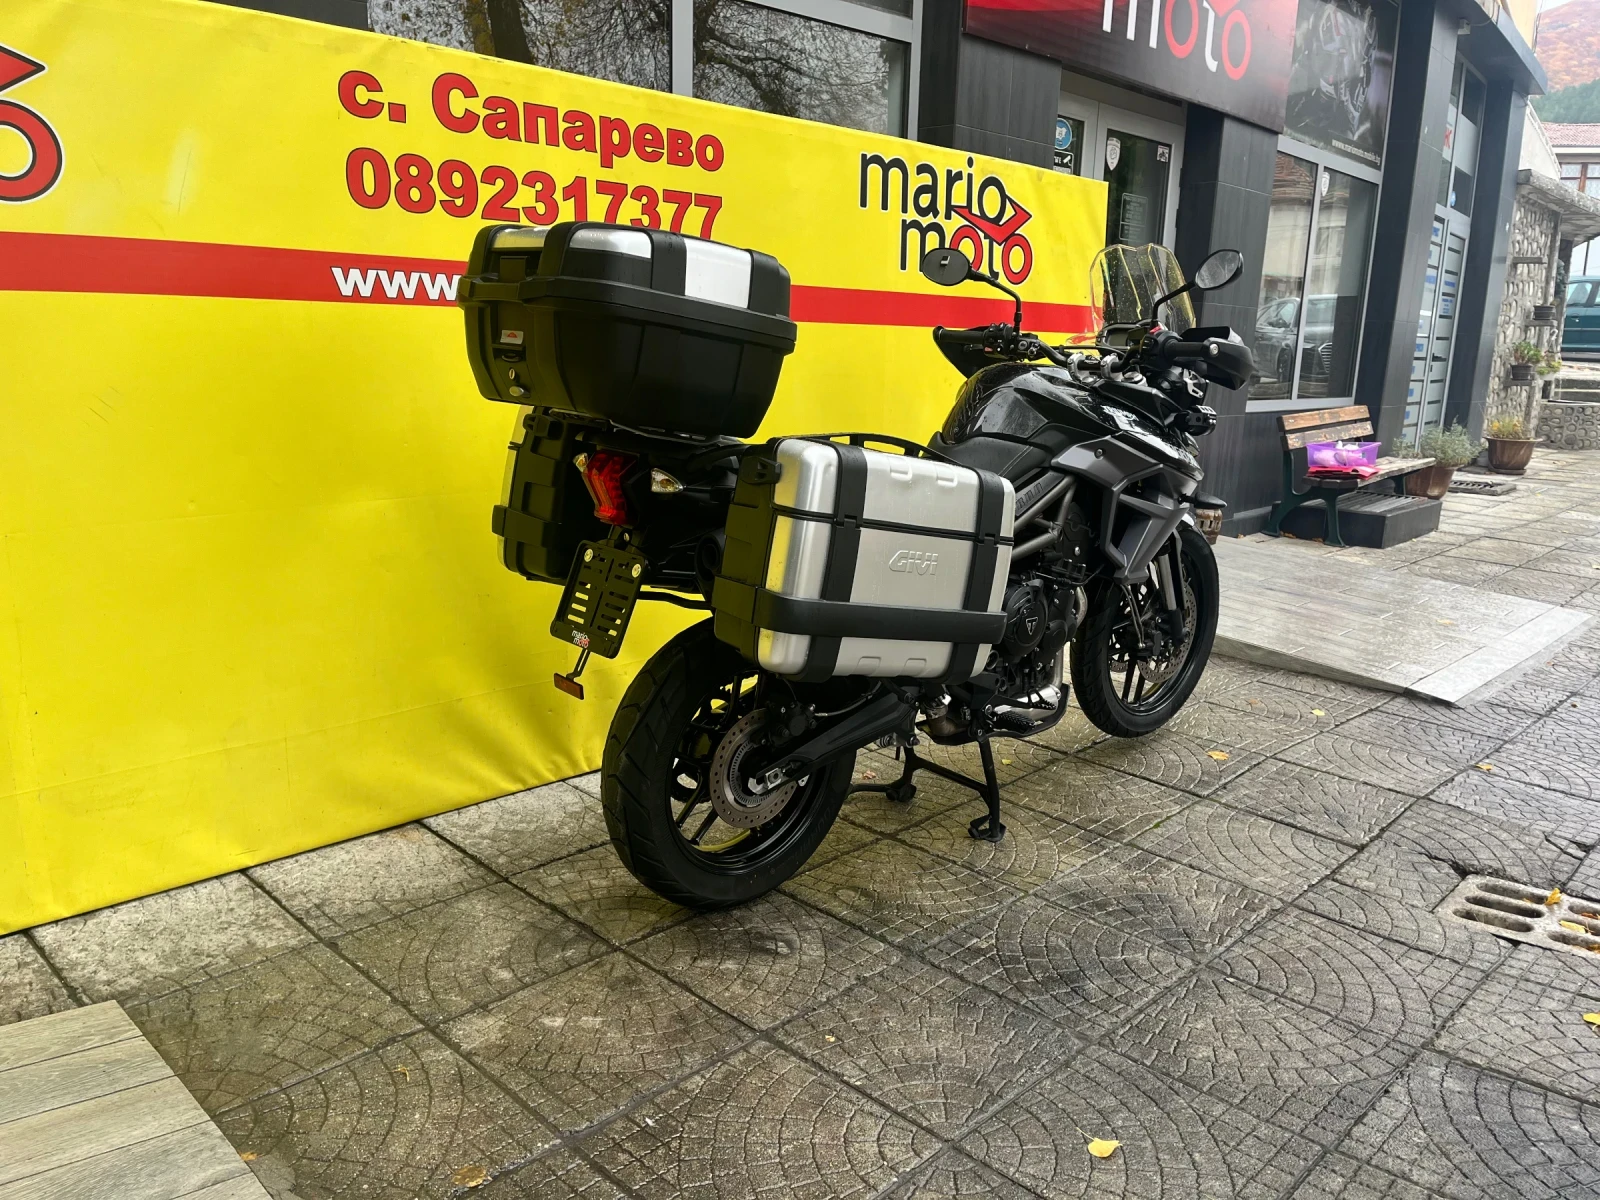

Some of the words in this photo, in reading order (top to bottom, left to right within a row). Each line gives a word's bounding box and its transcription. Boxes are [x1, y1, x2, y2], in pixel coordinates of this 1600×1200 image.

[338, 70, 407, 124] с.
[431, 72, 724, 172] Сапарево
[345, 147, 723, 240] 0892317377
[860, 153, 1008, 223] mario
[900, 218, 1033, 286] moto
[889, 550, 939, 576] GIVI
